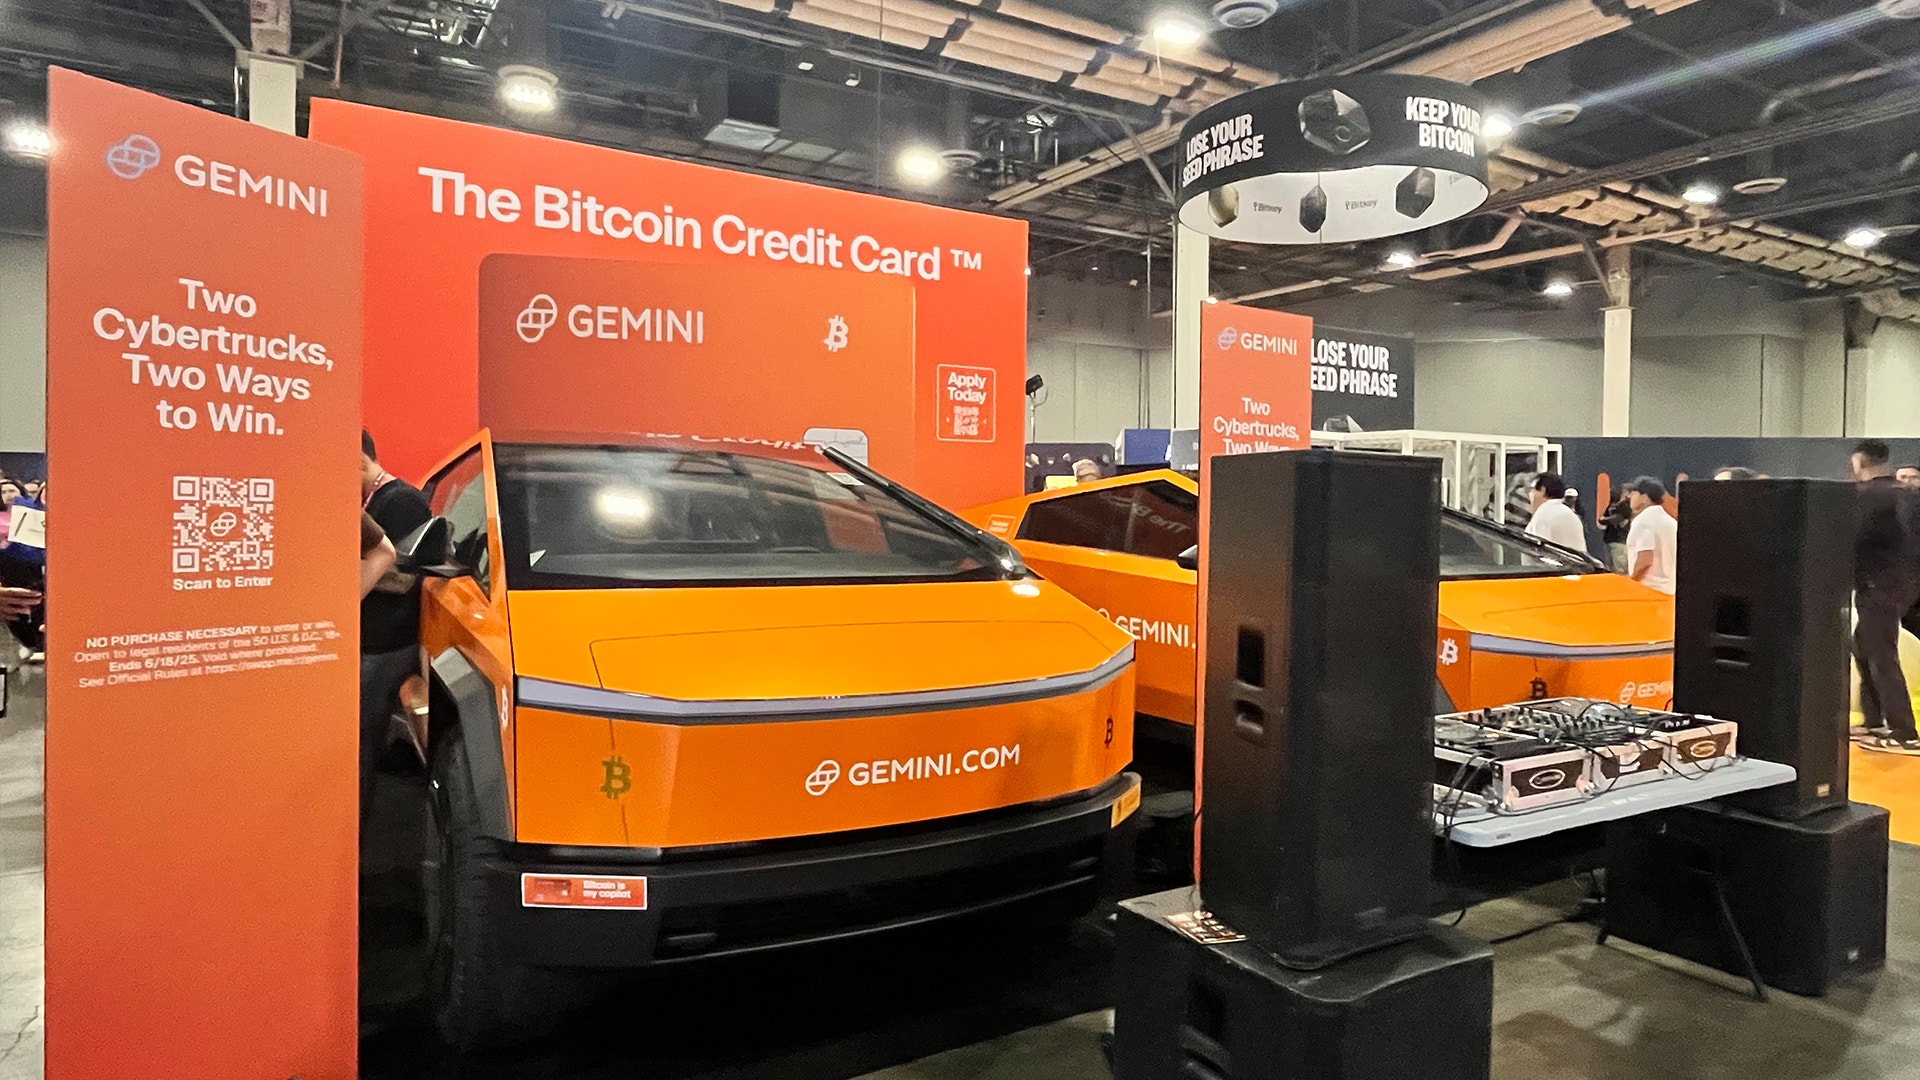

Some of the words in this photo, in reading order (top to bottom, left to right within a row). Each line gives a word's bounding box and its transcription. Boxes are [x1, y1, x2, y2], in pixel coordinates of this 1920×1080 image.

[1406, 96, 1449, 123] KEEP
[1450, 102, 1480, 136] YOUR
[1186, 128, 1209, 163] LOSE
[1210, 113, 1253, 148] YOUR
[1419, 122, 1475, 157] BITCOIN
[1182, 157, 1202, 188] SEED
[1203, 134, 1264, 175] PHRASE
[174, 154, 328, 217] GEMINI
[418, 166, 521, 223] The
[535, 184, 701, 250] Bitcoin
[712, 214, 843, 268] Credit
[850, 234, 940, 281] Card
[179, 278, 257, 318] Two
[93, 308, 333, 371] Cybertrucks,
[568, 304, 704, 344] GEMINI
[1240, 332, 1297, 356] GEMINI
[1310, 338, 1347, 366] LOSE
[1348, 343, 1390, 371] YOUR
[122, 352, 206, 390] Two
[215, 363, 310, 403] Ways
[947, 371, 987, 389] Apply
[1310, 365, 1338, 392] EED
[1339, 368, 1398, 398] PHRASE
[947, 386, 987, 405] Today
[1242, 397, 1270, 416] Two
[156, 400, 196, 430] to
[208, 402, 284, 435] Win.
[1213, 416, 1299, 441] Cybertrucks,
[1222, 438, 1252, 455] Two
[173, 578, 212, 591] Scan
[216, 577, 231, 588] to
[235, 576, 273, 588] Enter
[74, 651, 110, 663] Open
[113, 650, 127, 659] to
[130, 646, 160, 658] legal
[163, 642, 216, 654] residents
[218, 639, 230, 649] of
[233, 639, 251, 648] the
[253, 636, 269, 646] 50
[292, 633, 300, 643] &
[86, 637, 108, 648] NO
[111, 631, 183, 646] PURCHASE
[186, 626, 258, 640] NECESSARY
[260, 626, 271, 634] to
[273, 623, 299, 633] enter
[302, 623, 312, 631] or
[109, 660, 142, 672] Ends
[144, 654, 200, 669] 6/18/25.
[202, 652, 228, 662] Void
[229, 649, 263, 660] where
[79, 677, 105, 688] See
[107, 671, 151, 685] Official
[154, 668, 188, 680] Rules
[190, 667, 202, 676] at
[848, 744, 1020, 787] GEMINI.COM
[583, 880, 616, 890] Bitcoin
[617, 881, 626, 890] is
[583, 890, 597, 899] my
[598, 890, 632, 899] copilot
